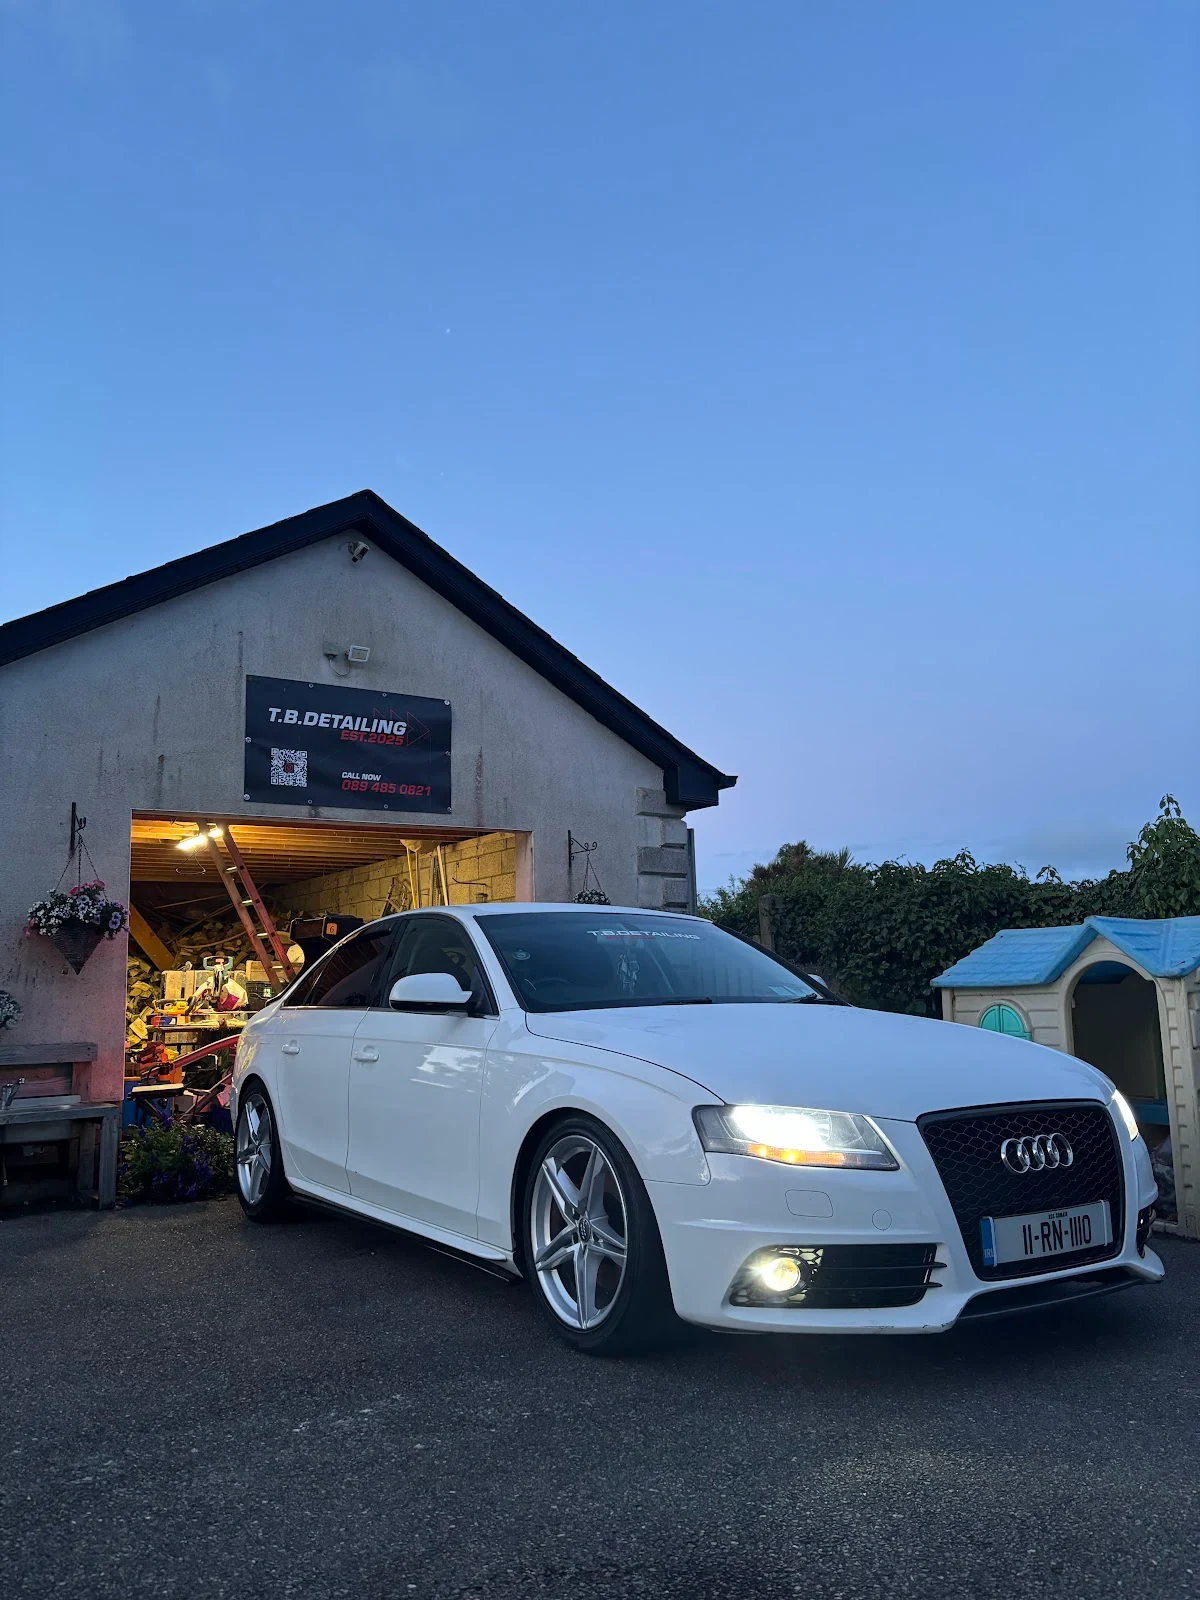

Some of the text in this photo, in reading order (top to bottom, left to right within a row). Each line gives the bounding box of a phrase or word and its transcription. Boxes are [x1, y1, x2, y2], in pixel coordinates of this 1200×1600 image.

[268, 707, 408, 736] T.B.DETAILING
[340, 731, 405, 746] EST.2025
[341, 771, 382, 781] CALL NOW
[341, 780, 431, 797] 089 485 0821
[1022, 1214, 1092, 1255] 11-RN-1110
